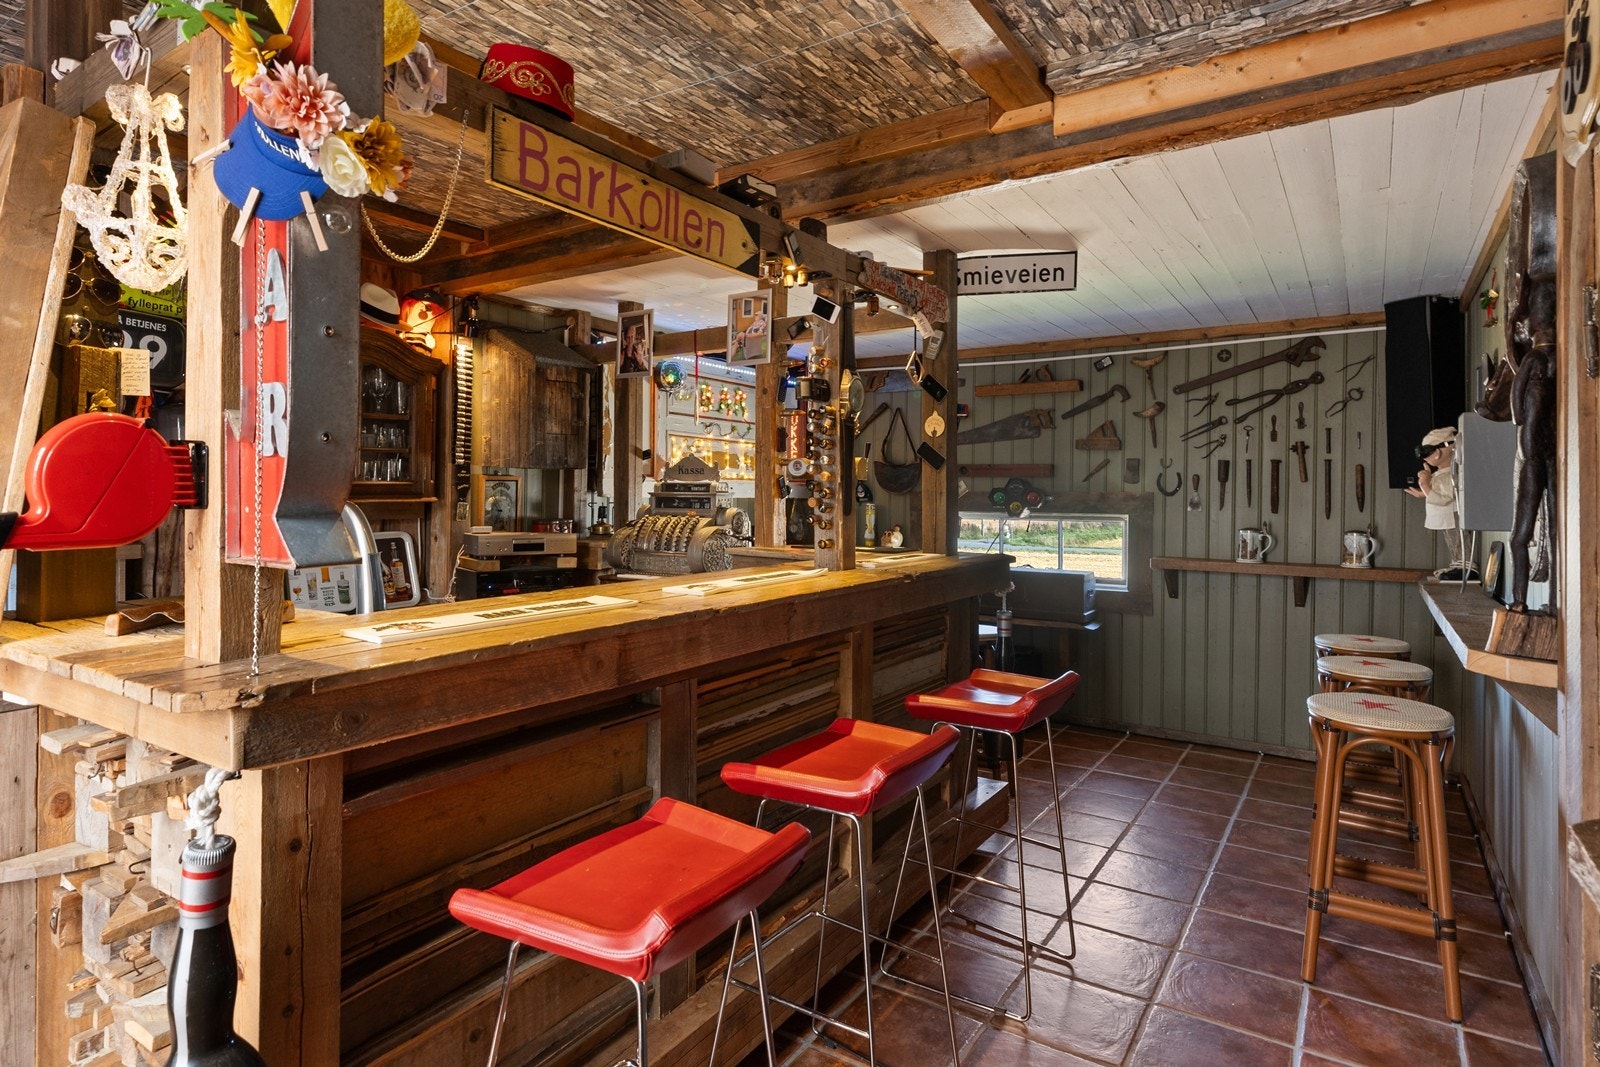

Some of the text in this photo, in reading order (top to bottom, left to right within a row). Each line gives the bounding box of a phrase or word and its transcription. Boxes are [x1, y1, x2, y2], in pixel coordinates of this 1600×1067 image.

[519, 122, 725, 257] Barkollen
[957, 263, 1064, 286] mieveien
[127, 297, 183, 316] fylleprat p
[125, 317, 167, 332] BETJENES
[262, 247, 288, 457] AR
